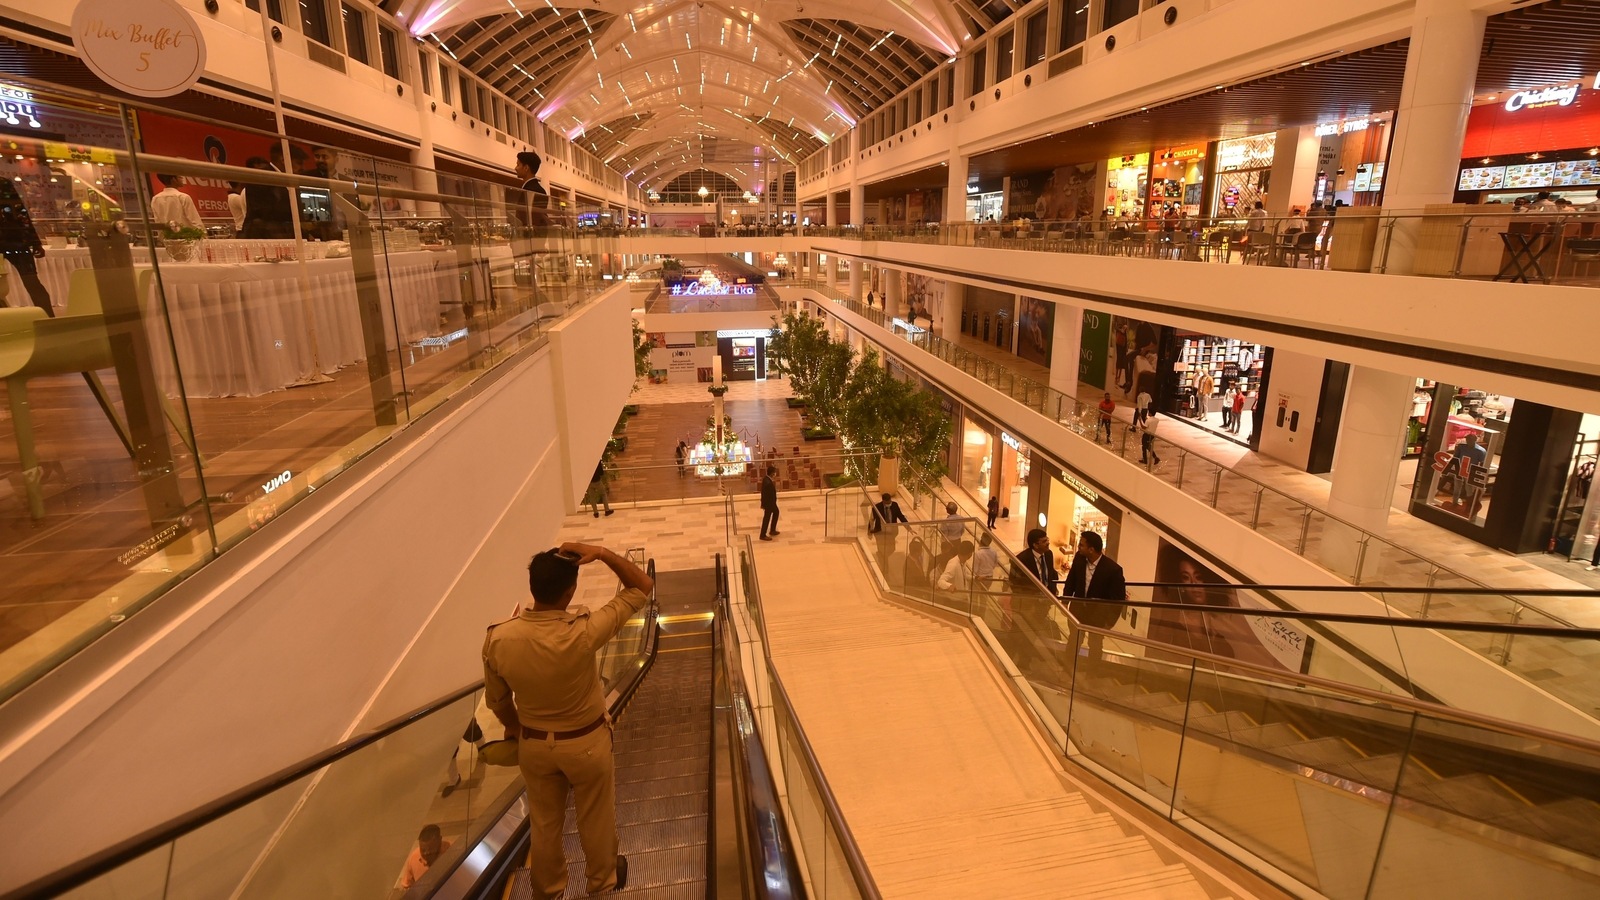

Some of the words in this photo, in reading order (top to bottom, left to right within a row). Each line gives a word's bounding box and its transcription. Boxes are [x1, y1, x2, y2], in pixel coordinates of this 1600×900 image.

[84, 18, 124, 40] Mix
[127, 23, 195, 51] Buffet
[135, 51, 151, 72] 5
[1173, 148, 1199, 158] CHICKEN
[1001, 432, 1020, 450] ONLY
[1431, 451, 1488, 489] SALE
[1272, 627, 1301, 651] MALL
